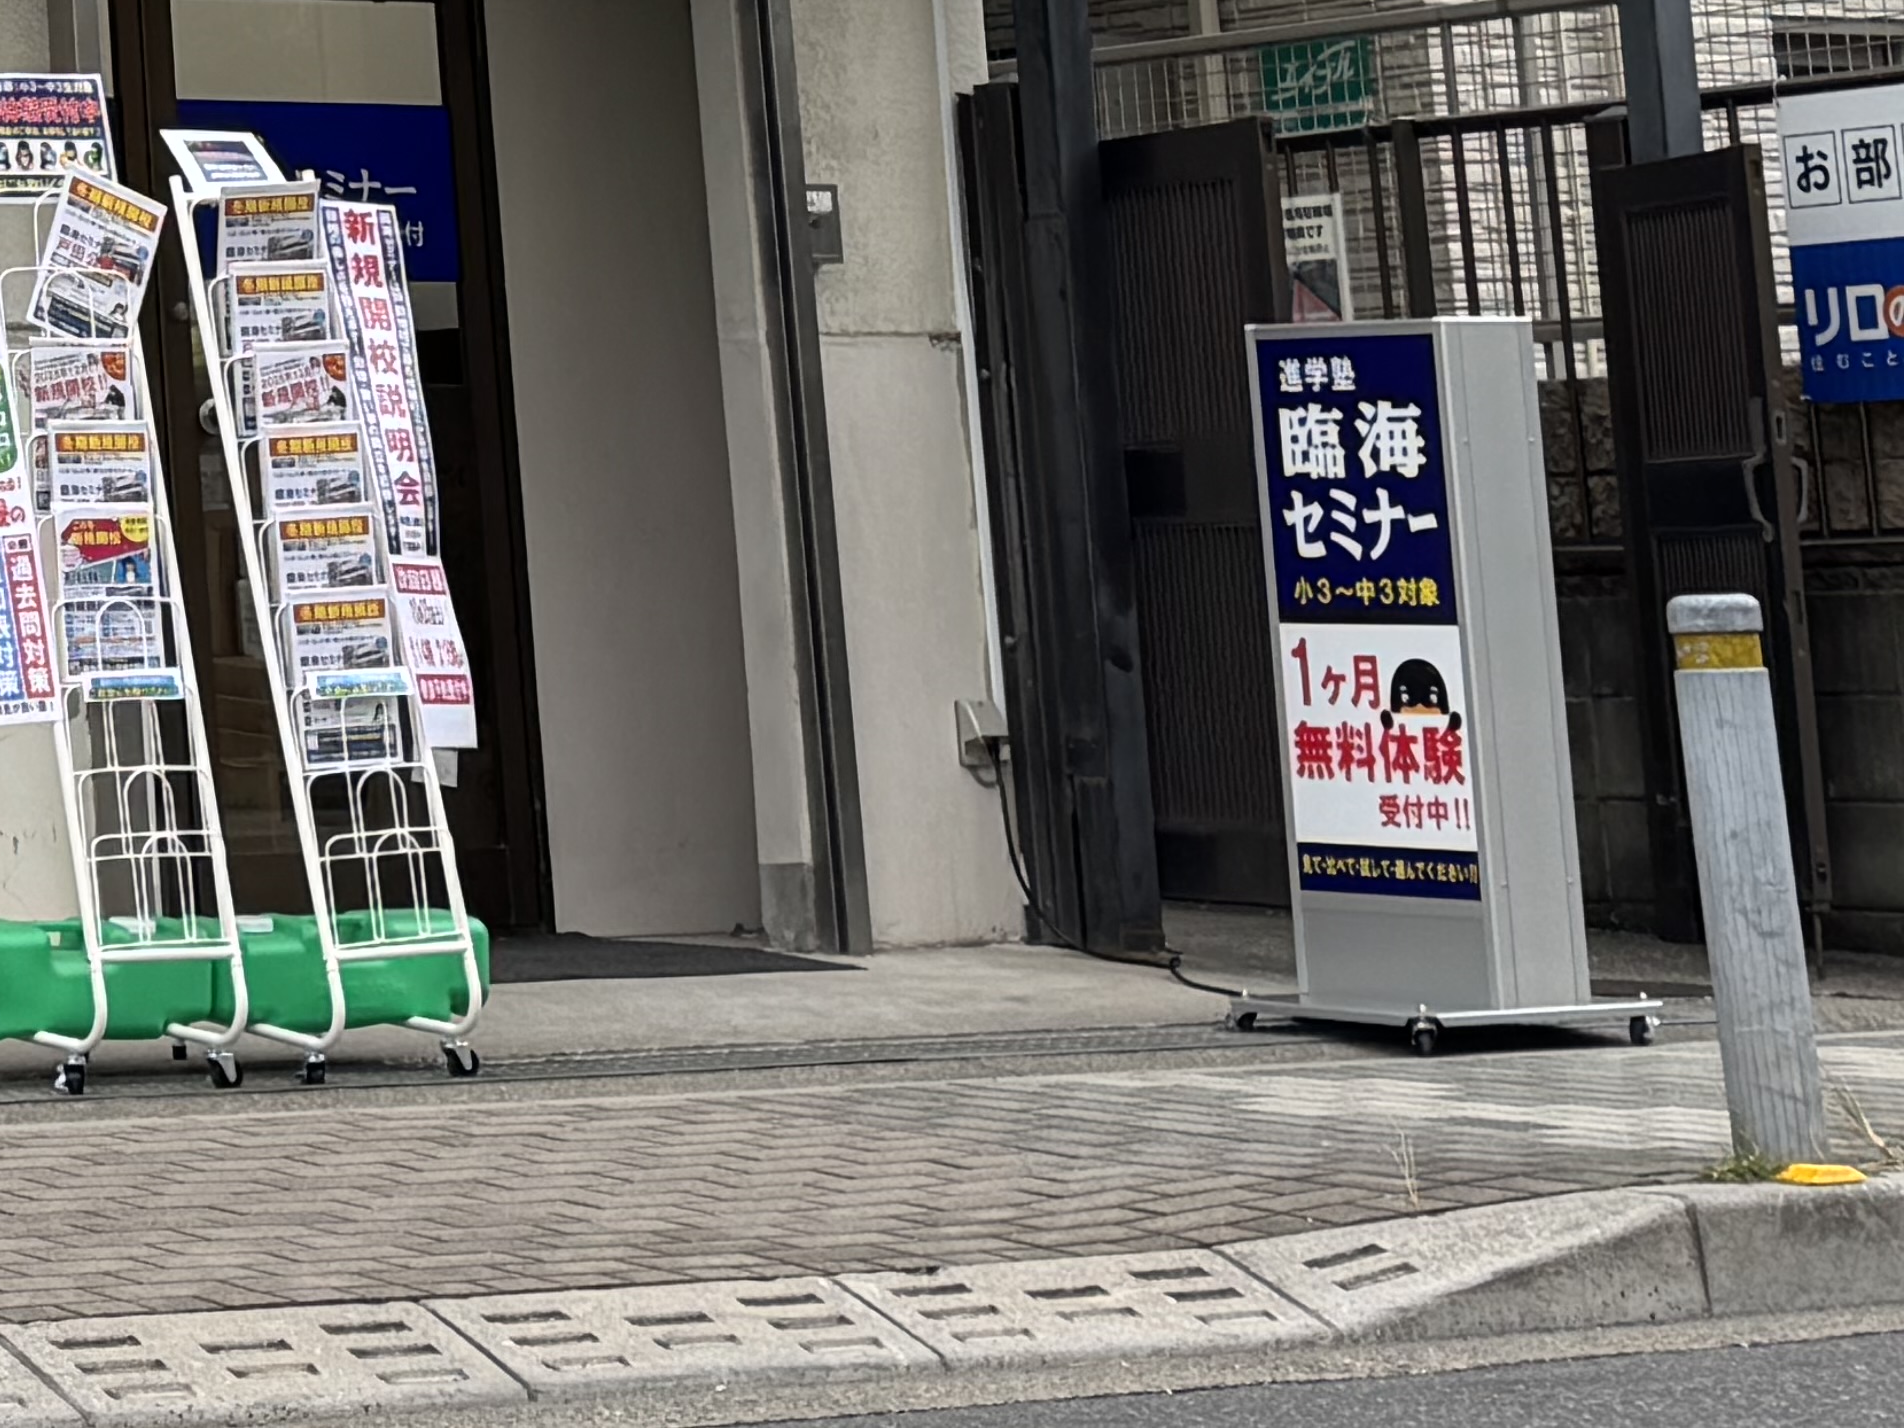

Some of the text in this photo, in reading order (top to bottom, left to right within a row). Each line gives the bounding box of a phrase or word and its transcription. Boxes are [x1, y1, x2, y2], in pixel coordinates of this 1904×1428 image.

[325, 167, 418, 203] ミナー
[343, 207, 421, 506] 新規開校説明会
[1278, 355, 1357, 393] 進学塾
[1278, 400, 1428, 480] 臨海
[1281, 486, 1439, 562] セミナー
[10, 554, 52, 695] 過去問対策
[1293, 719, 1467, 786] 無料体験
